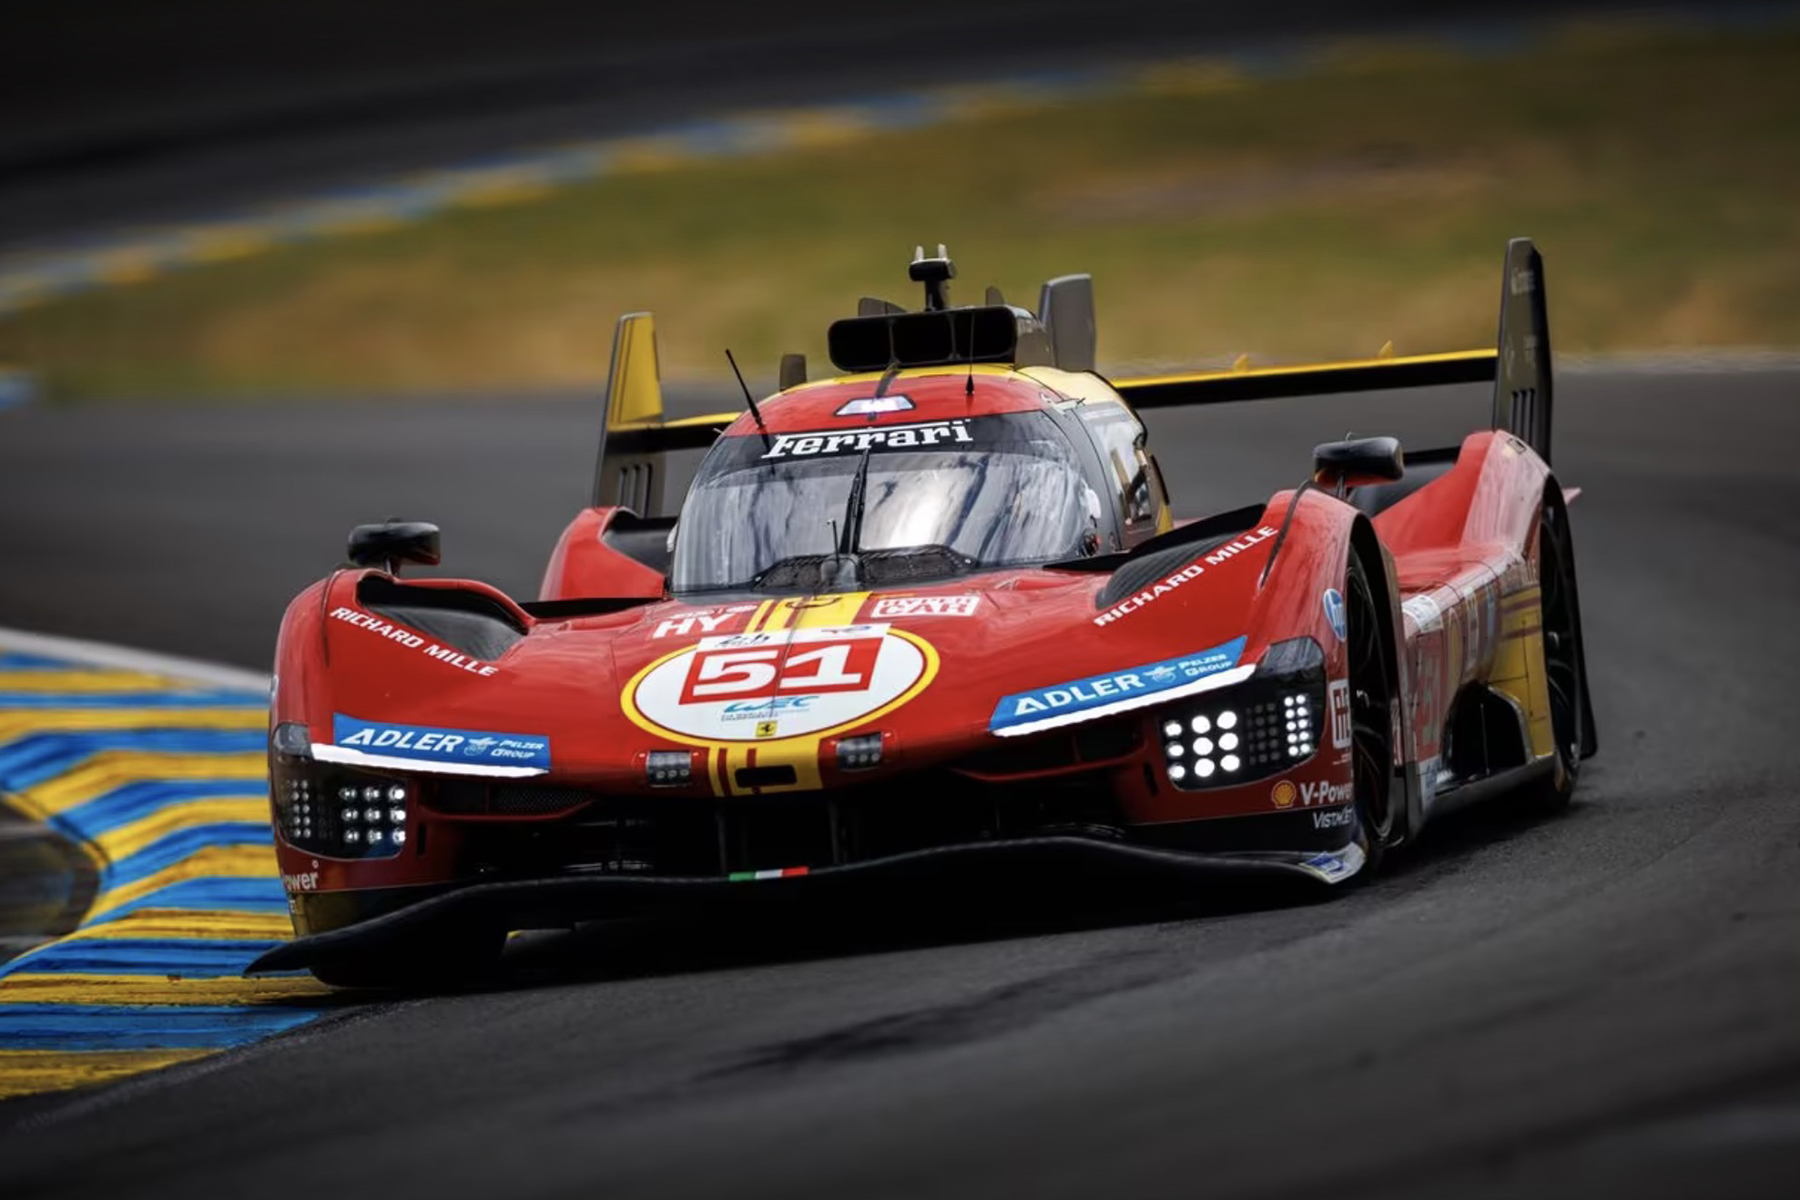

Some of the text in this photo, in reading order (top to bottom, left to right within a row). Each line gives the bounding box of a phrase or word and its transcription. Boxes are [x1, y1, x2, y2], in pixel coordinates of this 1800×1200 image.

[761, 418, 974, 459] Ferrari
[1093, 525, 1279, 627] RICHARD MILLE
[329, 606, 499, 677] RICHARD MILLE
[693, 644, 863, 697] 51
[1178, 653, 1227, 669] PELZER
[1184, 660, 1234, 677] GROUP
[1013, 673, 1146, 716] ADLER
[340, 727, 466, 754] ADLER
[490, 747, 536, 760] GROUP
[499, 739, 546, 750] PELZER
